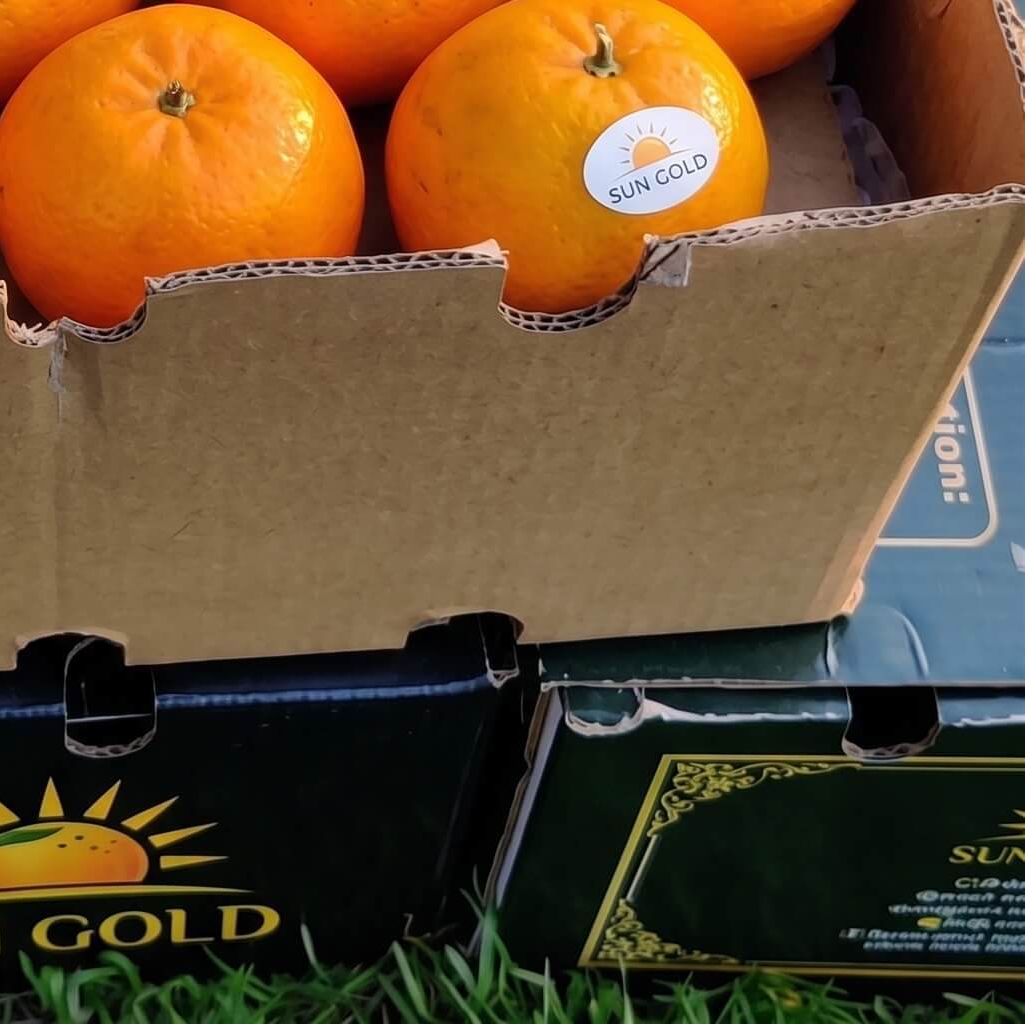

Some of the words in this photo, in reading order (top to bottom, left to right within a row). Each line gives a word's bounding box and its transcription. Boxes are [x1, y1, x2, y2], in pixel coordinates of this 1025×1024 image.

[609, 176, 651, 204] SUN
[655, 154, 708, 185] GOLD
[32, 904, 280, 952] GOLD
